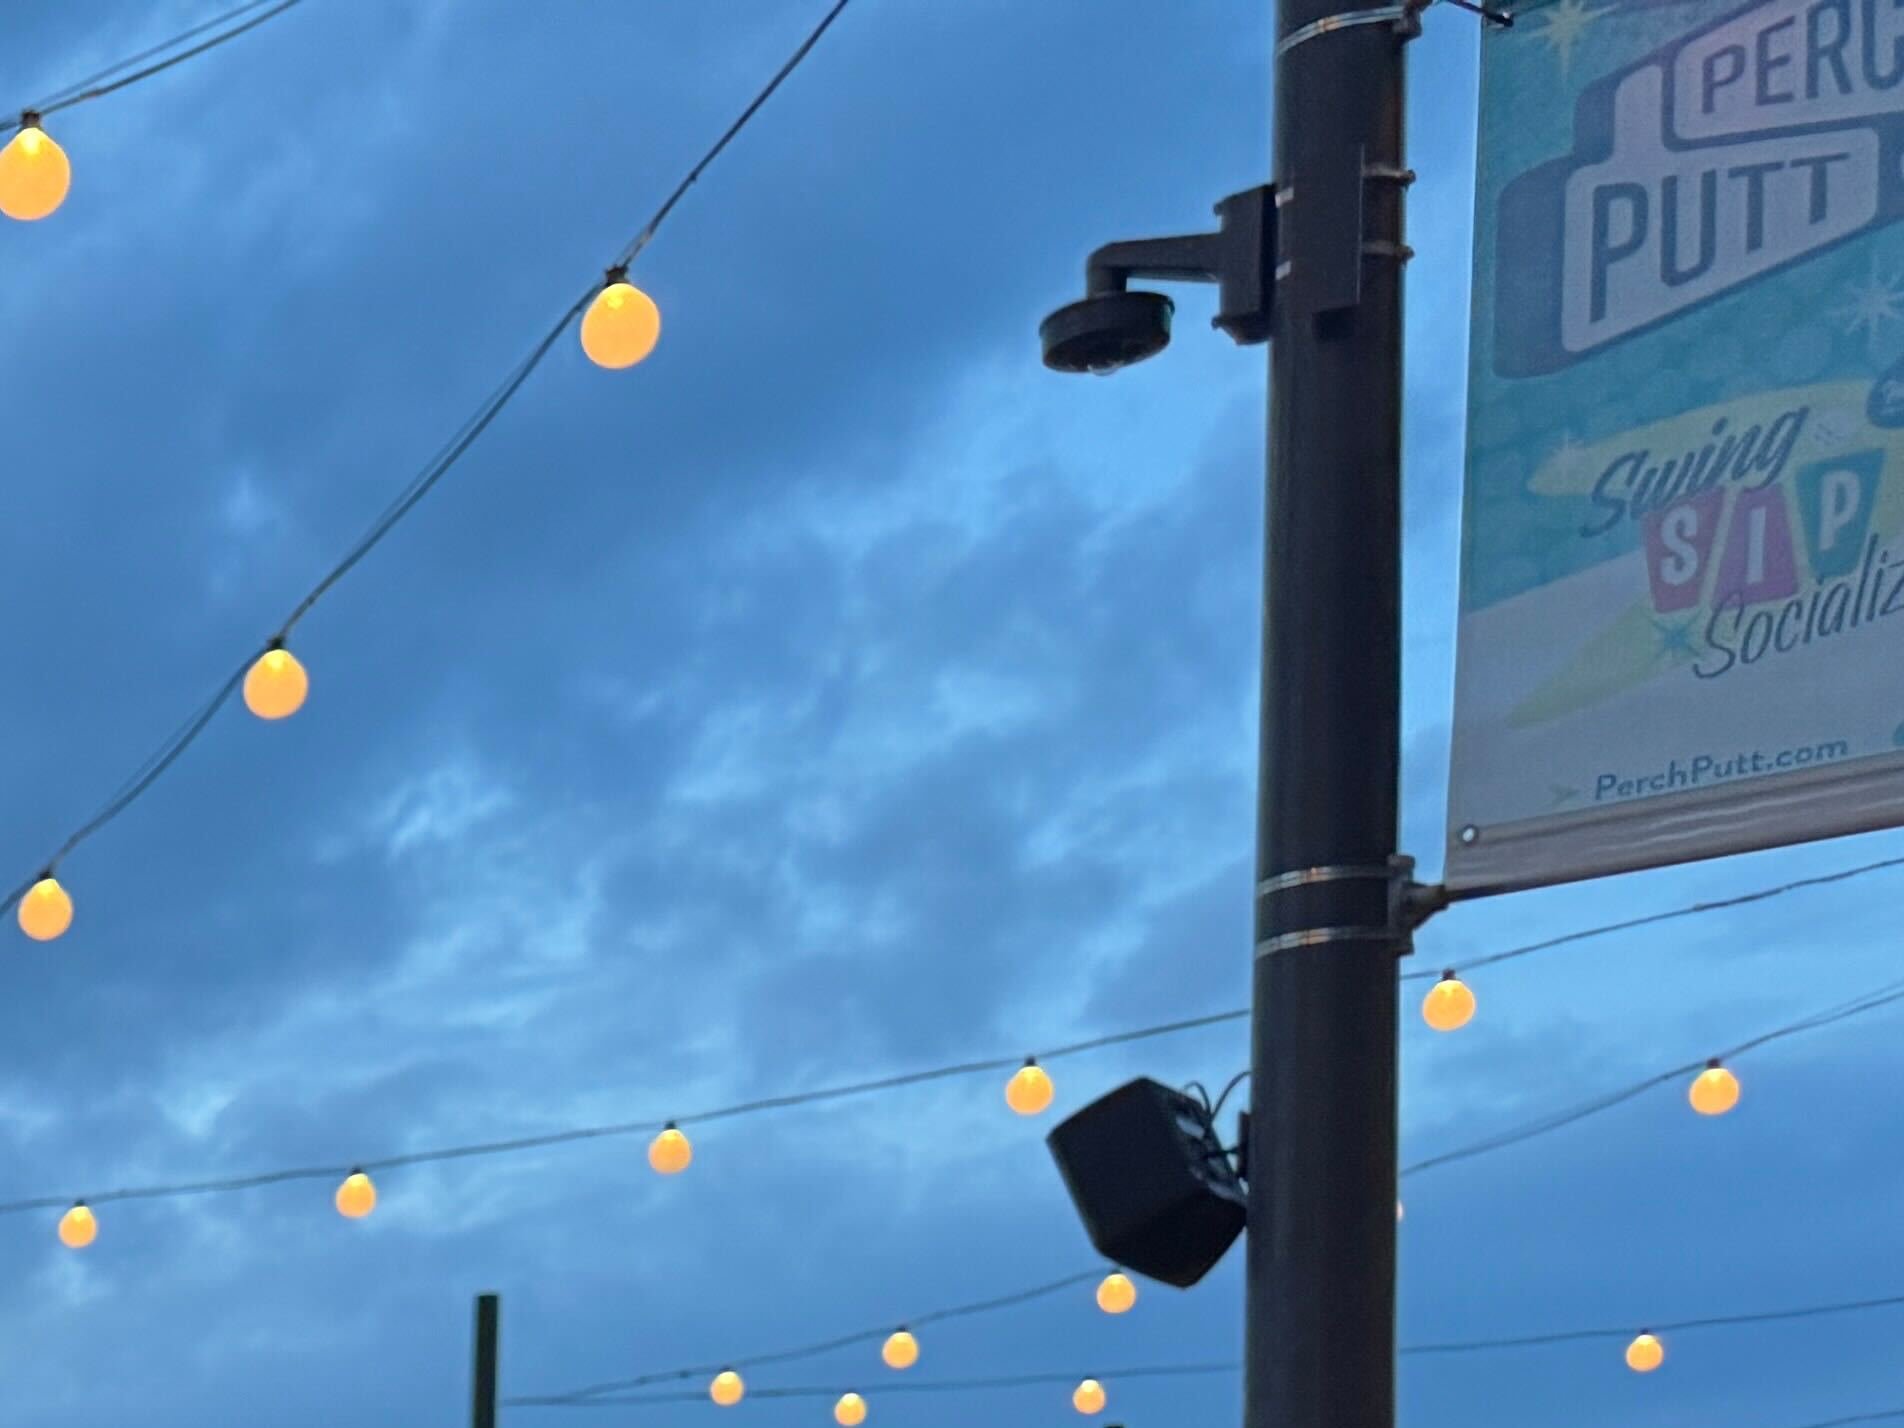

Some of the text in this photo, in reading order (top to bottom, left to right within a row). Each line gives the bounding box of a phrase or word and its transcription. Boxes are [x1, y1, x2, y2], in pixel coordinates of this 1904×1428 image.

[1589, 152, 1852, 324] PUTT
[1580, 405, 1810, 538] Swing
[1660, 469, 1861, 587] SIP
[1594, 737, 1849, 801] PerchPutt.com
